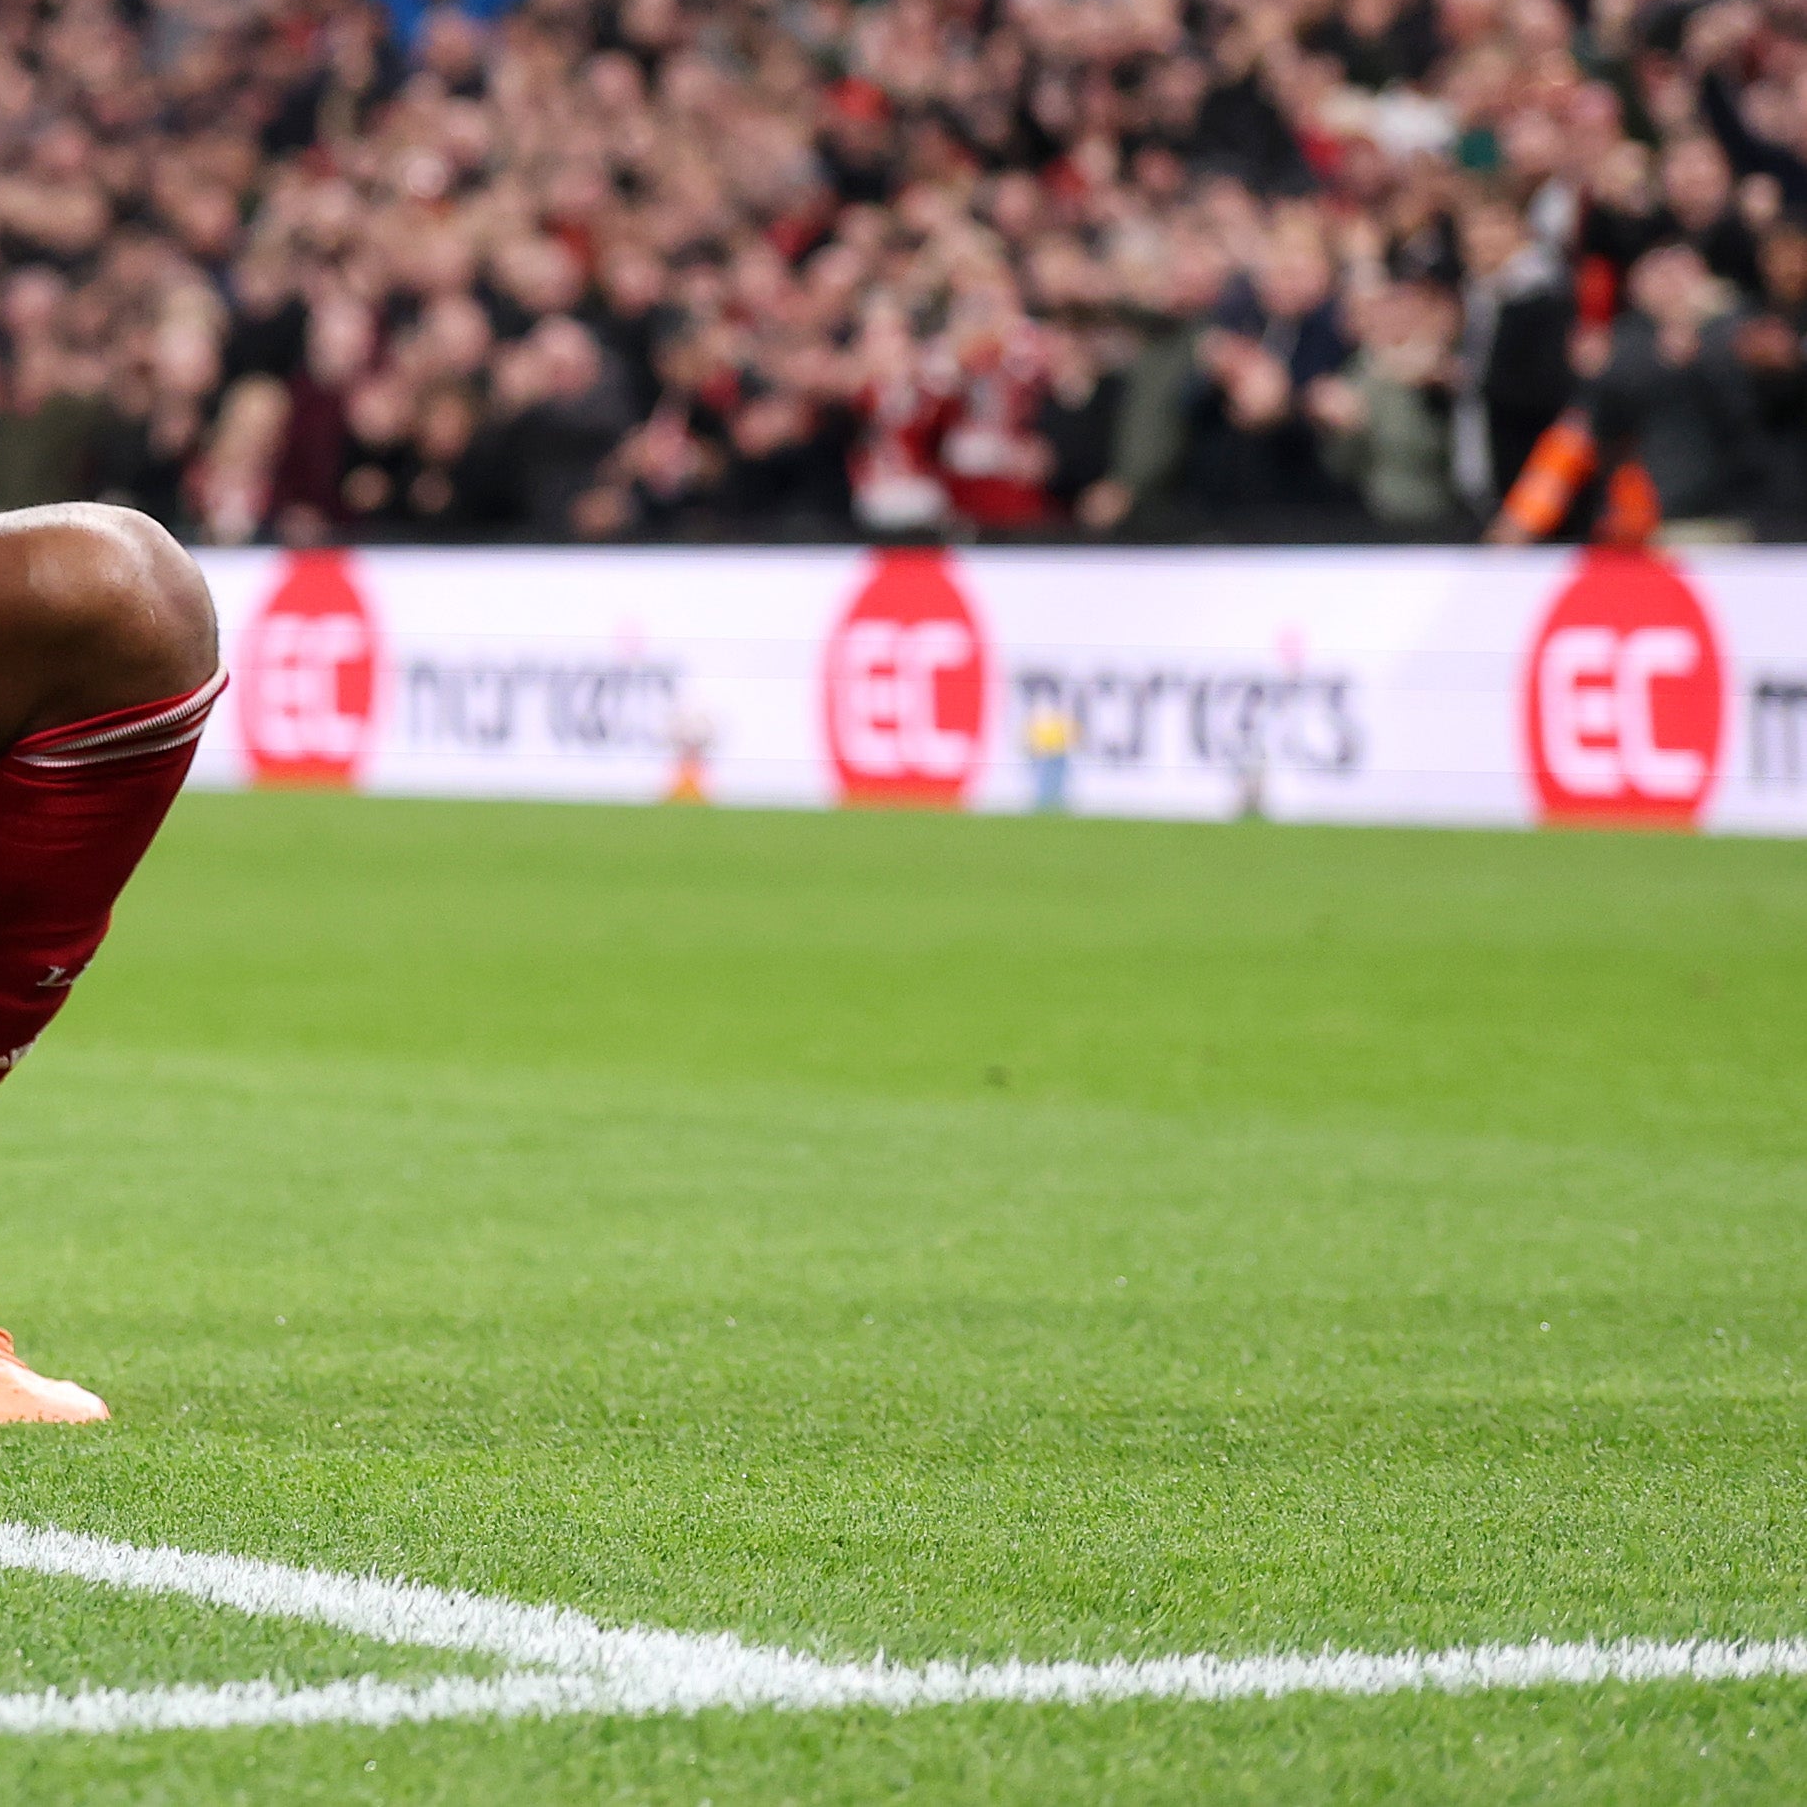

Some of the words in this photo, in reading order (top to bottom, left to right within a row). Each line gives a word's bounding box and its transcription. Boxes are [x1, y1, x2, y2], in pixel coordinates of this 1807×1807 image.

[255, 611, 367, 764] EC
[841, 617, 978, 778] EC
[1538, 623, 1705, 801] EC
